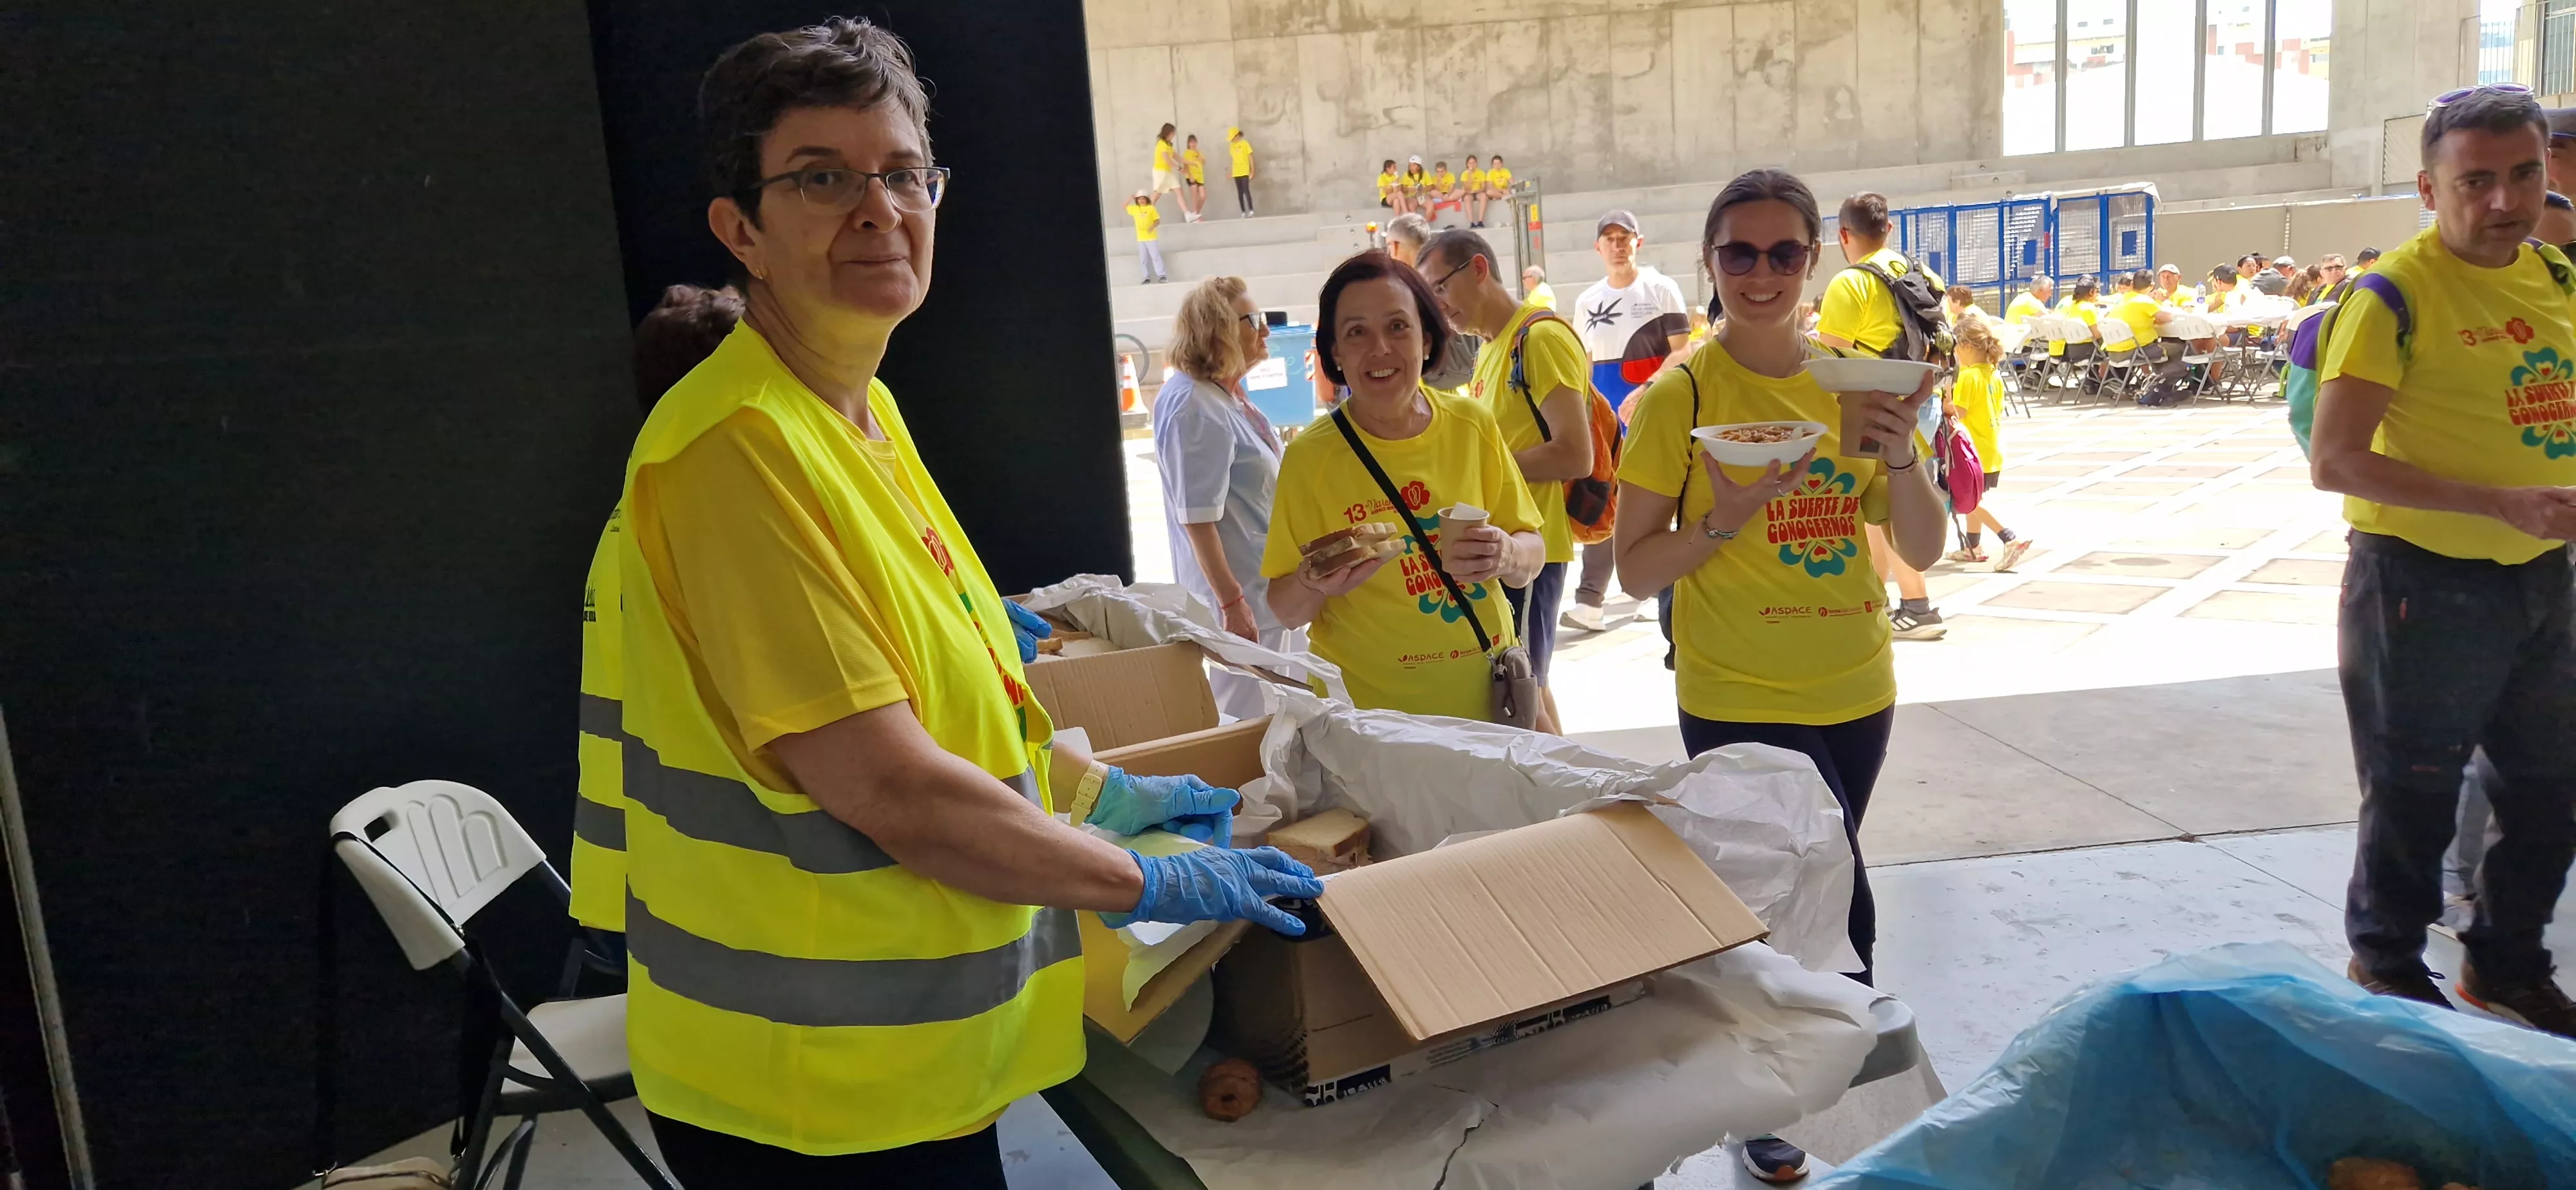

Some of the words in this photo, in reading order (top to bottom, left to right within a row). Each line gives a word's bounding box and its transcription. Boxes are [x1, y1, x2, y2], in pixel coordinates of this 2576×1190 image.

[1766, 500, 1785, 522] LA
[1788, 496, 1840, 520] SUERTE
[1840, 496, 1860, 515] DE
[1767, 516, 1856, 544] CONOCERNOS
[1399, 556, 1421, 578] LA
